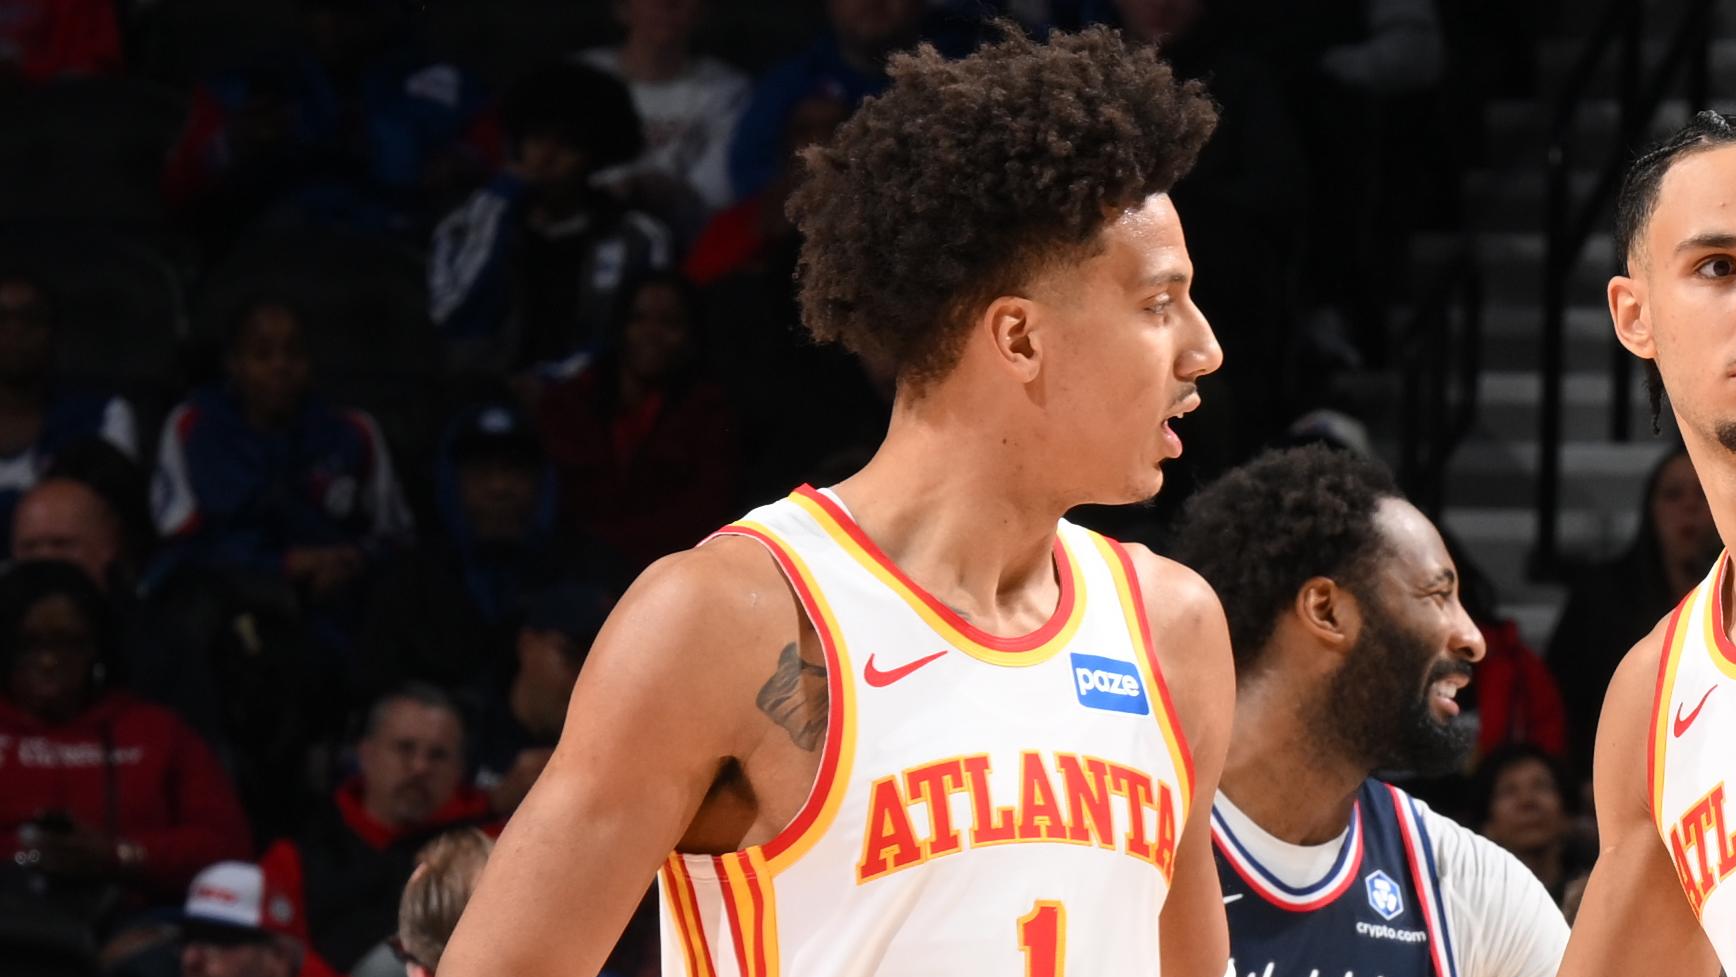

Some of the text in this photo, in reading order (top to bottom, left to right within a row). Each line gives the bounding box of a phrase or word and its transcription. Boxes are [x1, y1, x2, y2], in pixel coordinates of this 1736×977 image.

[1076, 666, 1140, 697] paze
[856, 749, 1178, 888] ATLANTA
[1355, 921, 1427, 943] crypto.com
